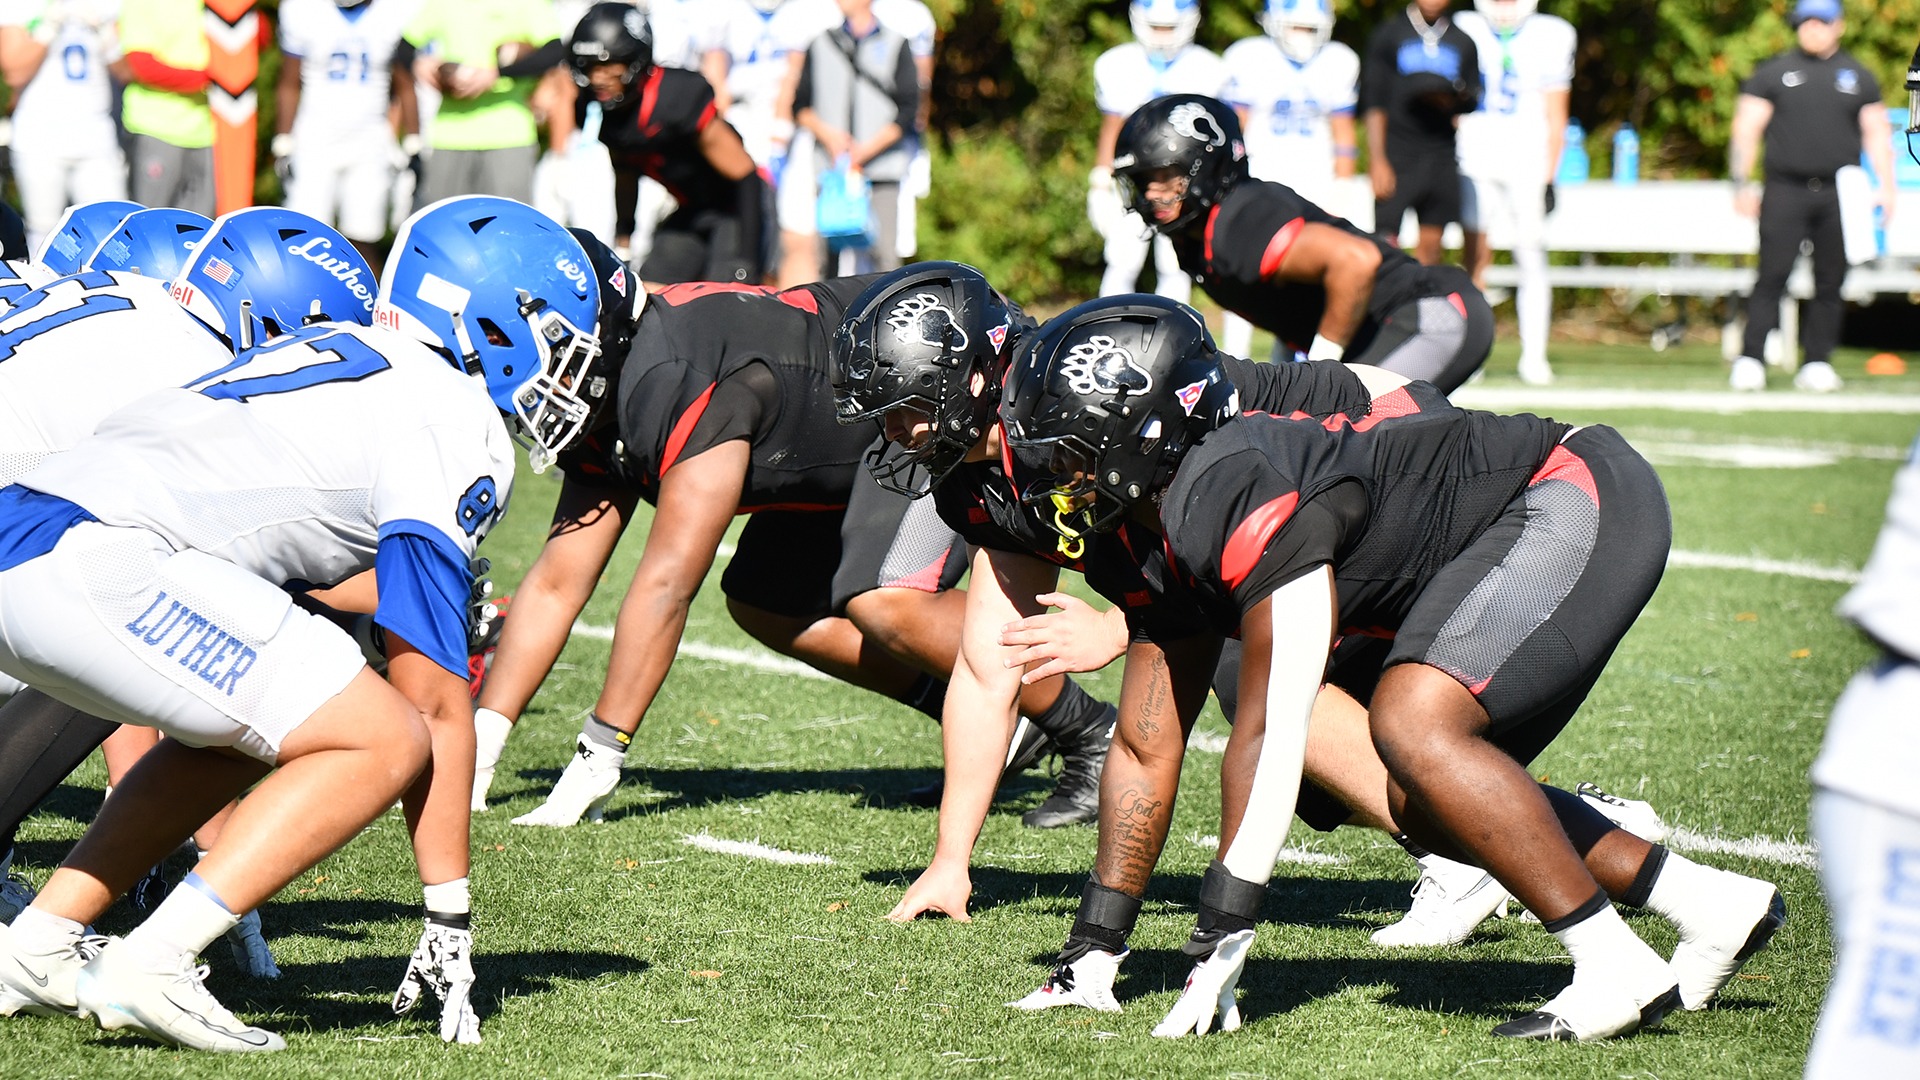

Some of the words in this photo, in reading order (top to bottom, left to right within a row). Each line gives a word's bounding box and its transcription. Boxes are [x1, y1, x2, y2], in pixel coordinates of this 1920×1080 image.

[288, 237, 375, 312] Luther
[182, 327, 393, 403] 7
[455, 475, 504, 546] 8
[125, 590, 257, 696] LUTHER
[1114, 789, 1162, 826] God
